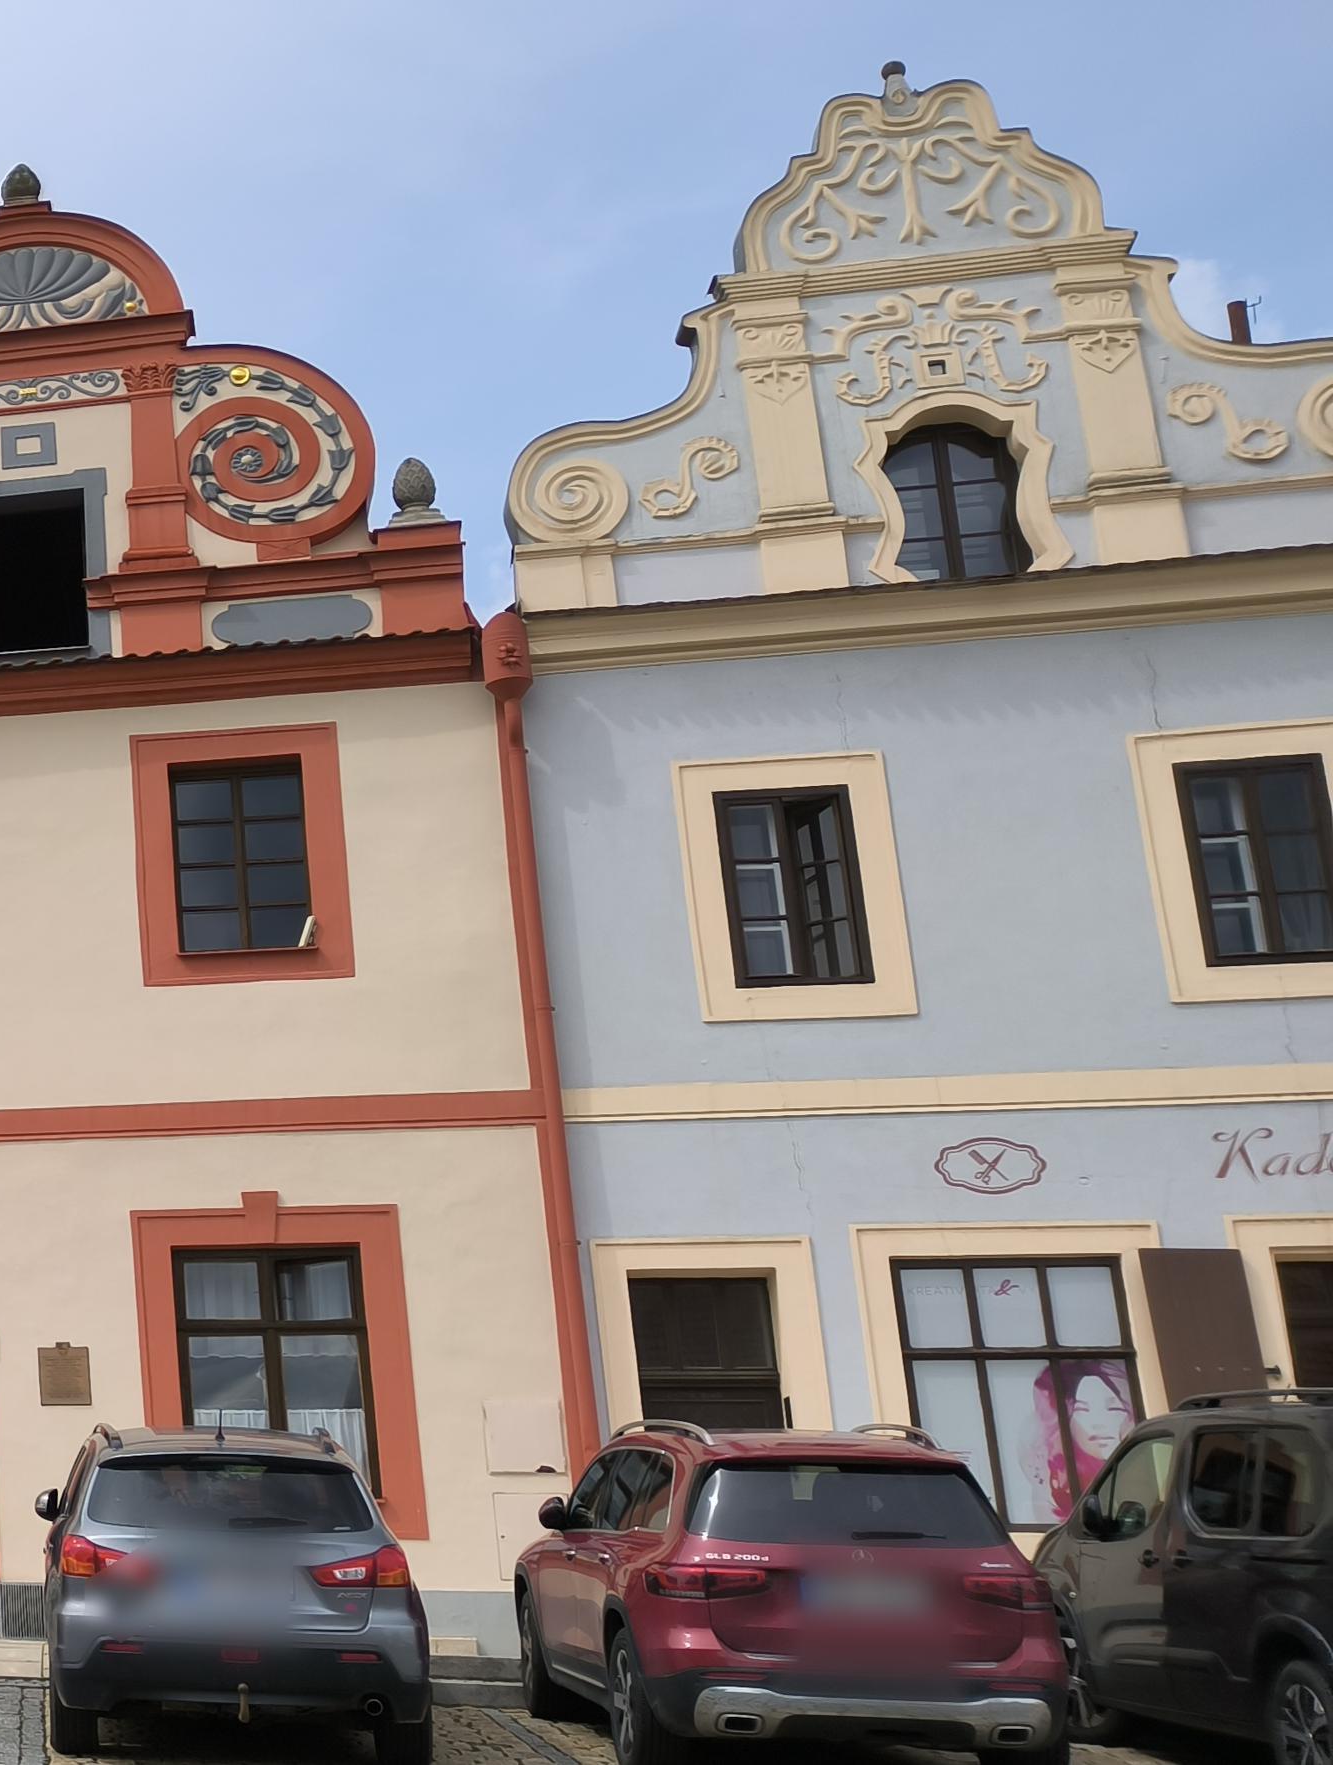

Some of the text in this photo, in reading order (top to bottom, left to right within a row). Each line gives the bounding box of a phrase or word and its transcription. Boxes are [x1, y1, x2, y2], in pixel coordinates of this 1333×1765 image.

[1212, 1127, 1333, 1184] Kad
[906, 1284, 996, 1297] KREATIVTA
[705, 1552, 732, 1560] GLB
